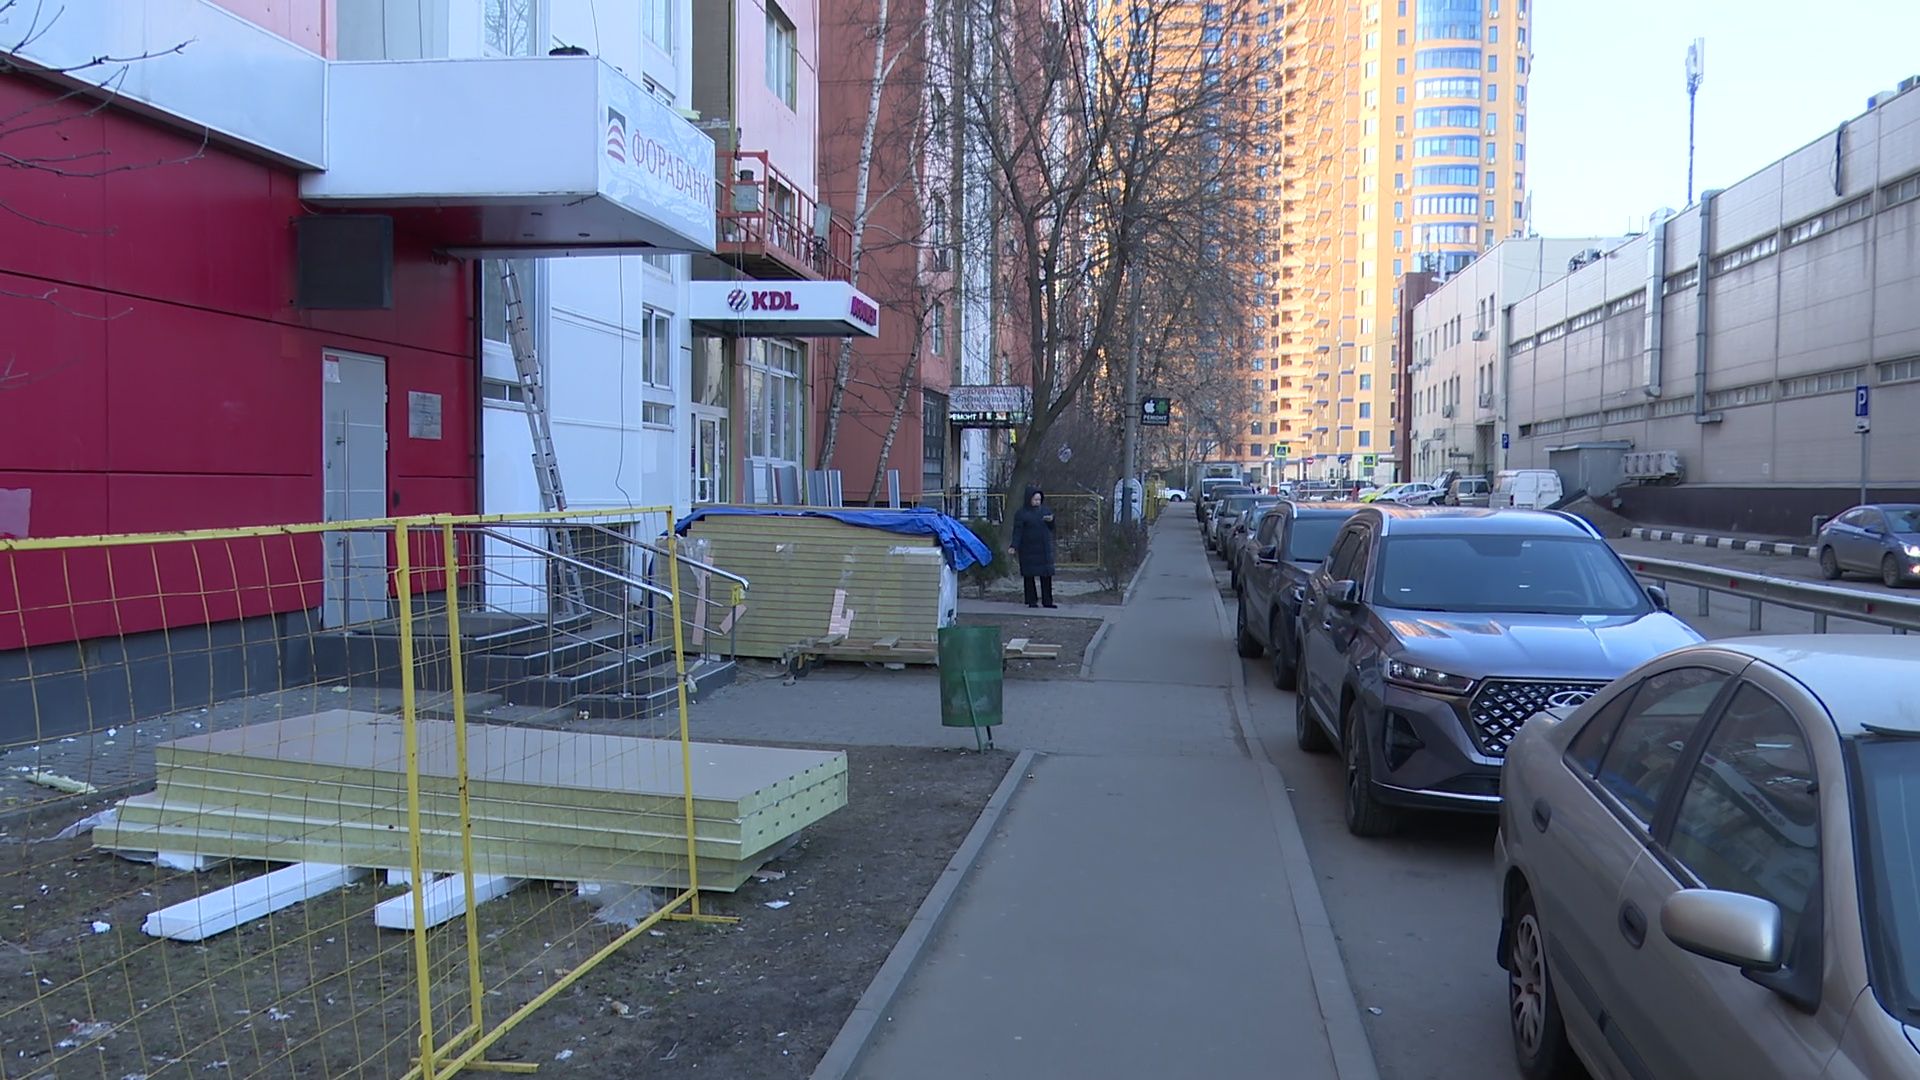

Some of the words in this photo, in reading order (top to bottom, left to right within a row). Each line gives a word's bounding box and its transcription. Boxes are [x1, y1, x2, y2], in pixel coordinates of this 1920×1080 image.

[632, 128, 711, 209] ФОРАБАНК
[751, 291, 799, 311] KDL
[1857, 390, 1867, 415] P
